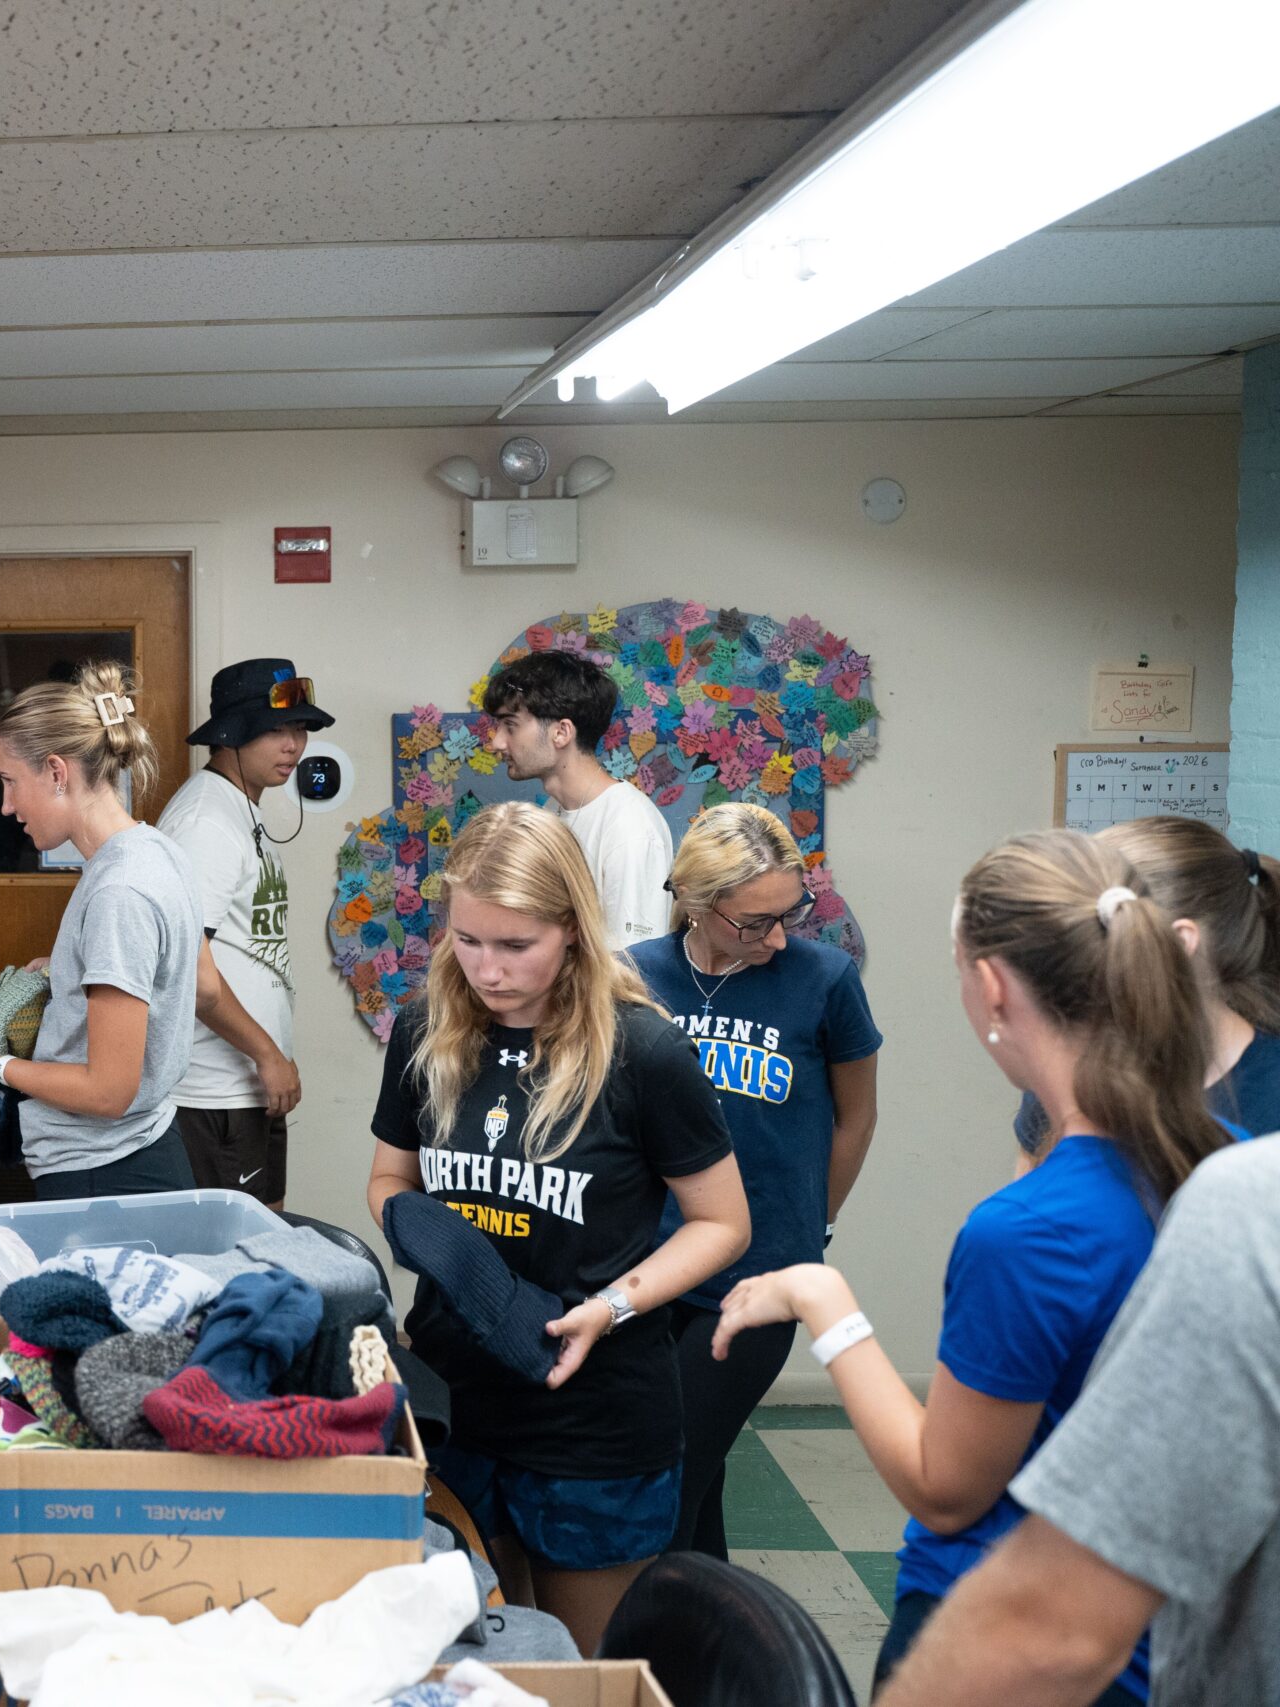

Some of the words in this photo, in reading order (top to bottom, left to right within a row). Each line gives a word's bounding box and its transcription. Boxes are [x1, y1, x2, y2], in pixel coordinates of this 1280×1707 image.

[1110, 700, 1157, 724] Sandy
[312, 773, 326, 784] 73
[1076, 783, 1082, 792] S
[1097, 783, 1106, 792] M
[1121, 783, 1128, 792] T
[1142, 783, 1152, 792] W
[1167, 783, 1174, 792] T
[1190, 783, 1196, 792] F
[1212, 783, 1219, 792] S
[485, 1117, 506, 1139] NP
[420, 1147, 493, 1194] NORTH
[499, 1158, 594, 1226] PARK
[446, 1201, 531, 1238] TENNIS
[43, 1503, 95, 1520] BAGS
[141, 1503, 227, 1521] APPAREL
